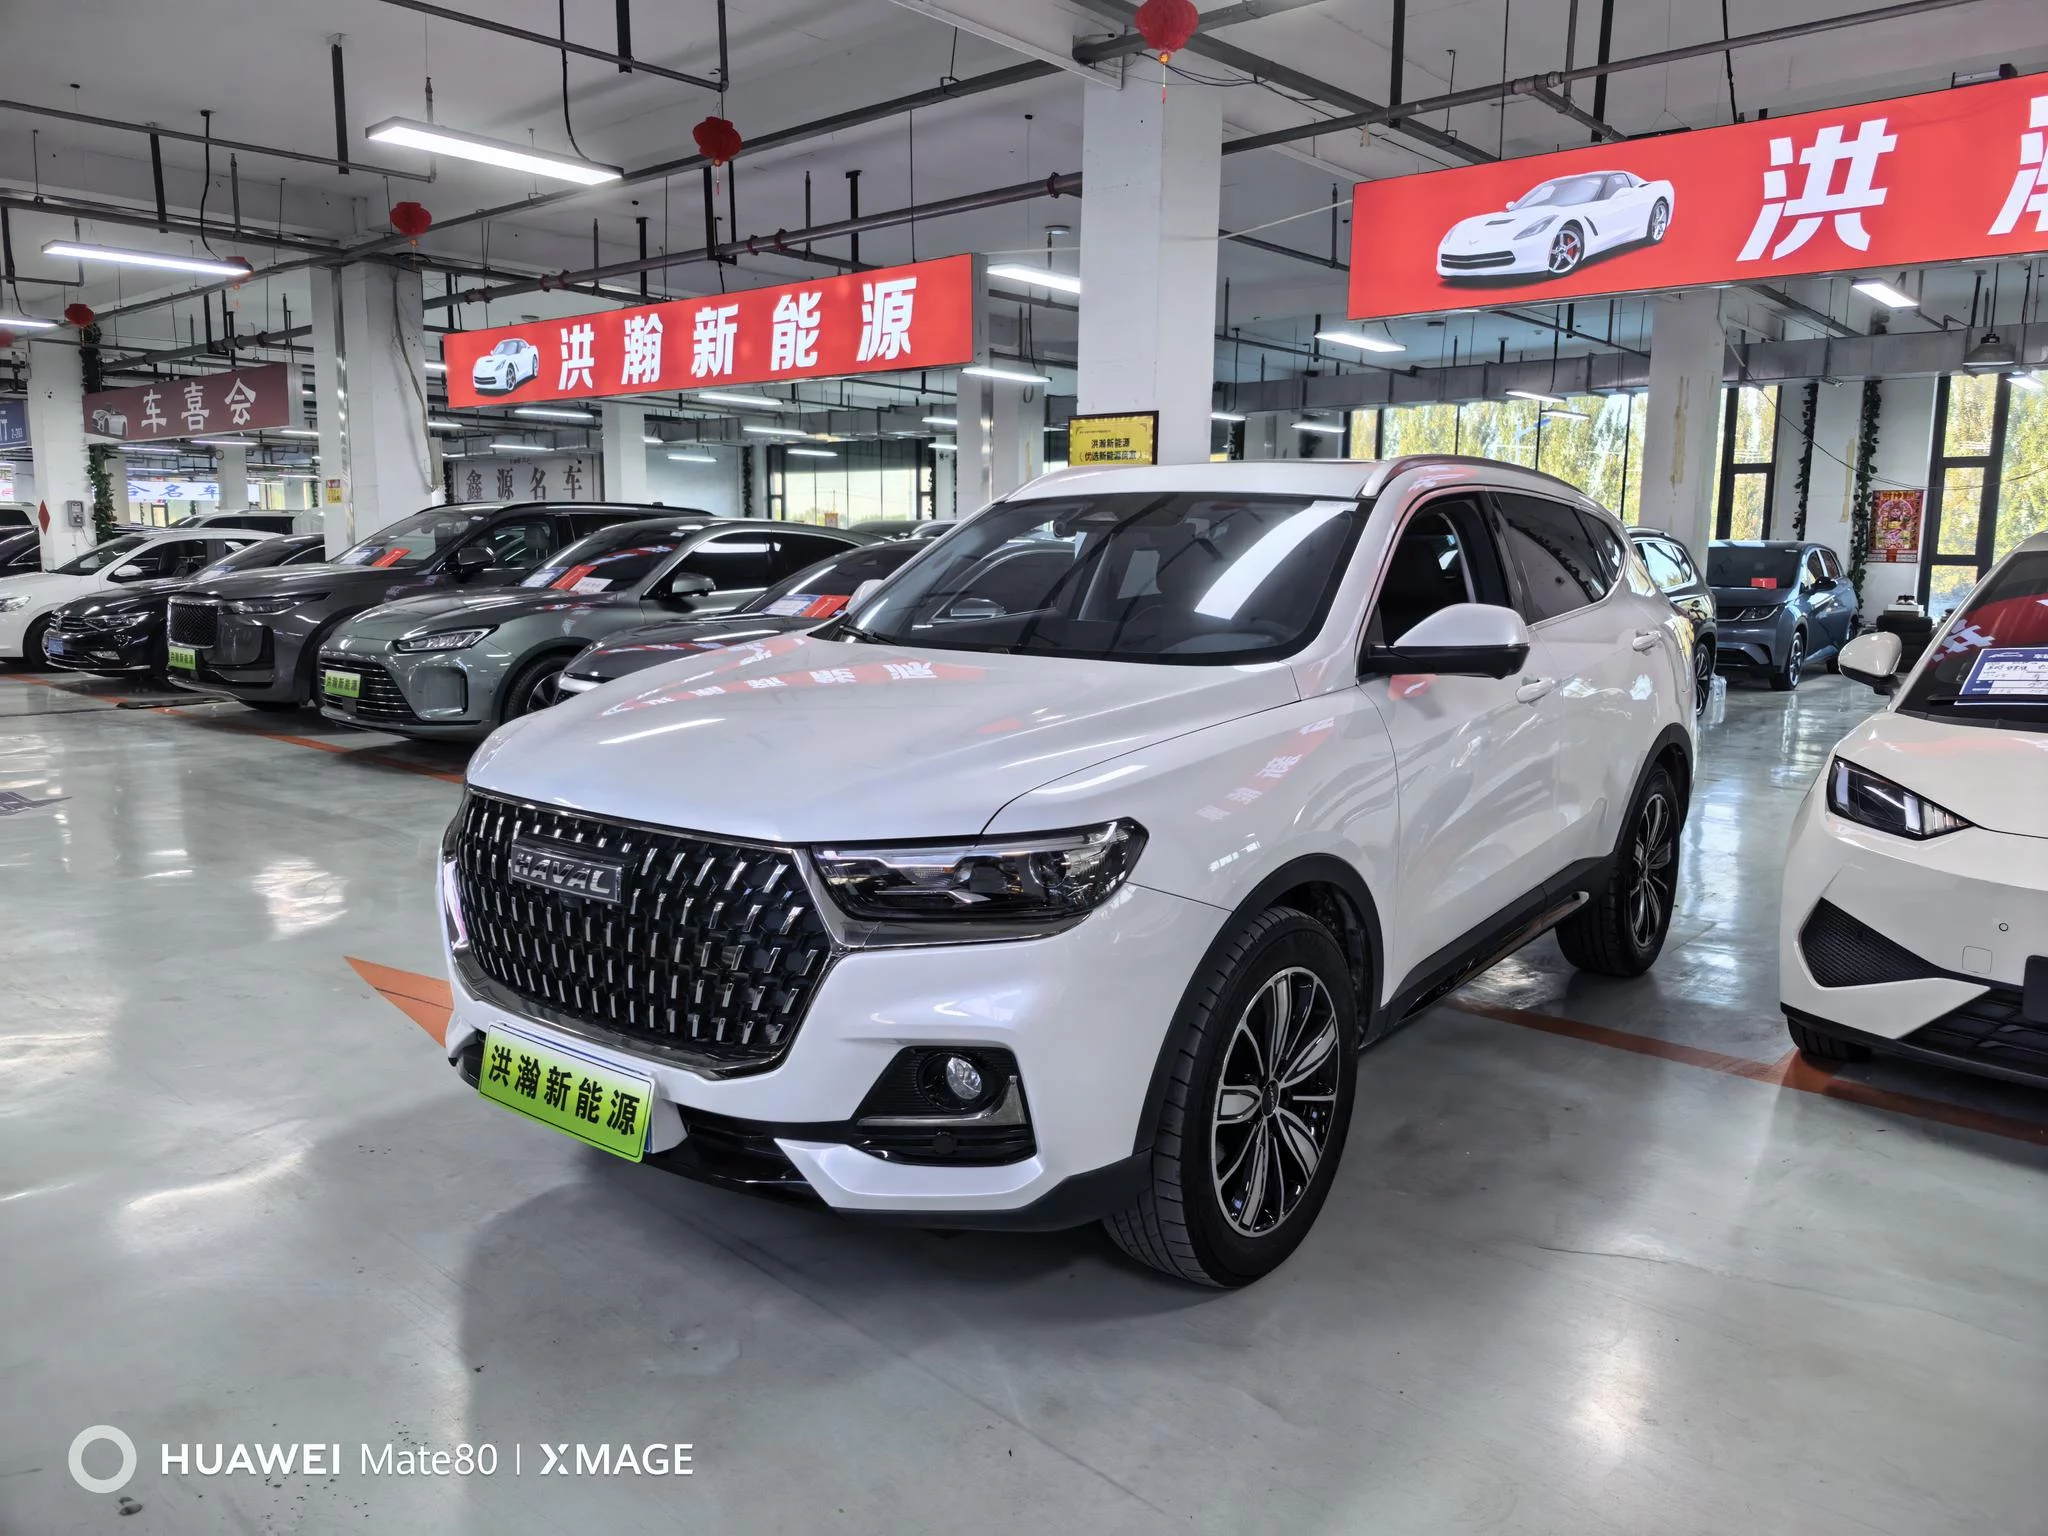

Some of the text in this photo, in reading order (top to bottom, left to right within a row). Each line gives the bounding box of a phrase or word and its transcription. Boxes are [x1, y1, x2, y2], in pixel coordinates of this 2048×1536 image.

[1736, 95, 2048, 262] 洪
[558, 277, 917, 391] 洪瀚新能源
[141, 378, 256, 433] 车喜会
[466, 464, 583, 500] 鑫源名车
[513, 852, 610, 895] HAVAL
[488, 1044, 641, 1137] 洪瀚新能源
